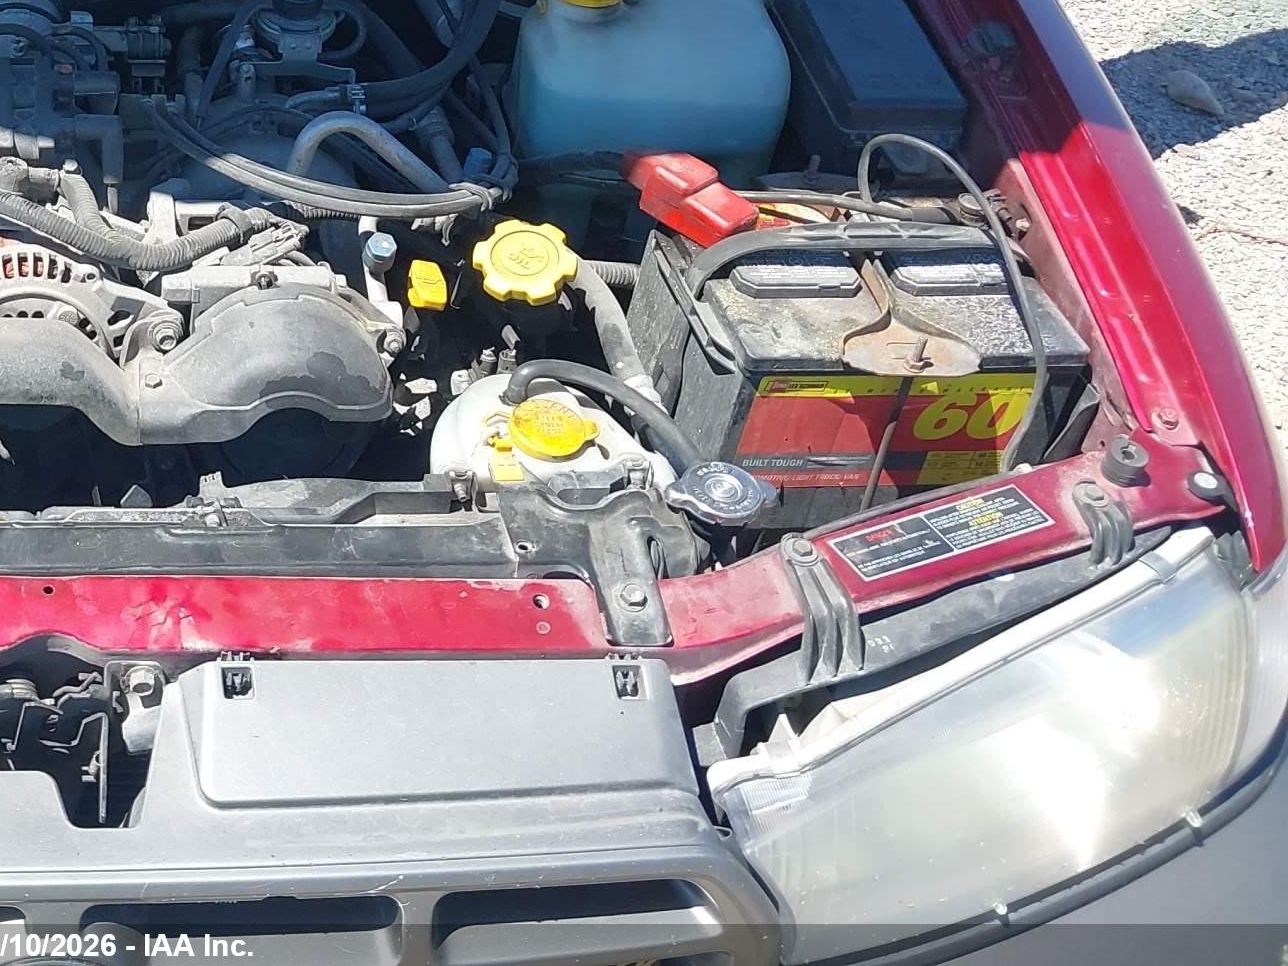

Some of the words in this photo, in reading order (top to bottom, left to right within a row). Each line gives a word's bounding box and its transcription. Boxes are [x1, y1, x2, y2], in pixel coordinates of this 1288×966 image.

[913, 389, 1031, 440] 60
[742, 459, 769, 467] BUILT
[770, 459, 804, 467] TOUGH
